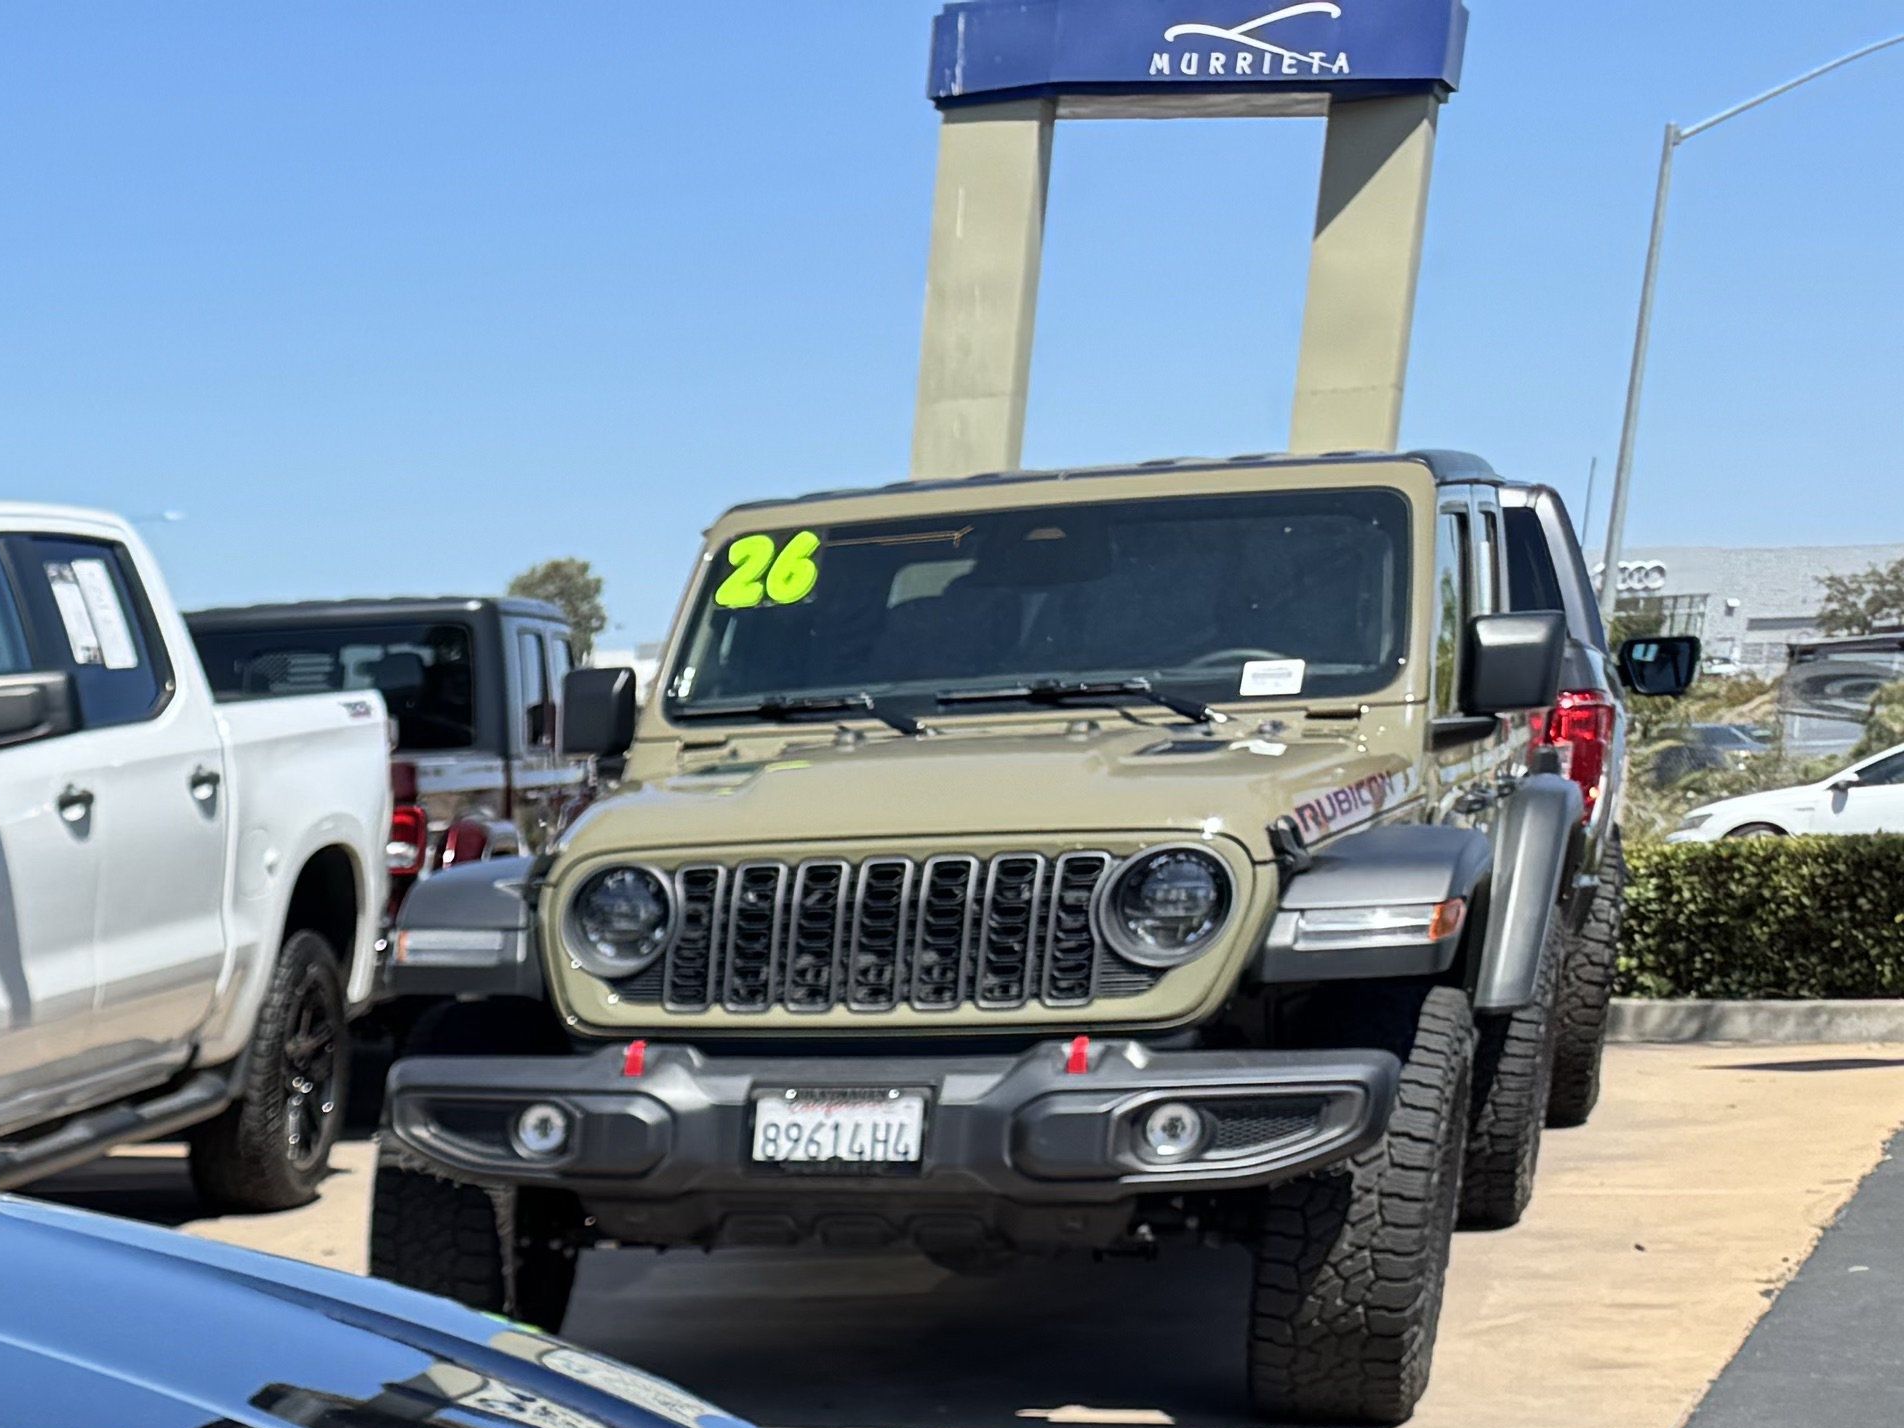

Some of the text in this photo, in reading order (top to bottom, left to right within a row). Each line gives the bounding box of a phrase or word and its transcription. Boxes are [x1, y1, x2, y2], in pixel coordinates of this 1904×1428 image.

[1149, 51, 1350, 75] MURRIETA
[715, 530, 820, 609] 26
[1294, 770, 1396, 833] RUBICON
[761, 1120, 910, 1160] 89614H4
